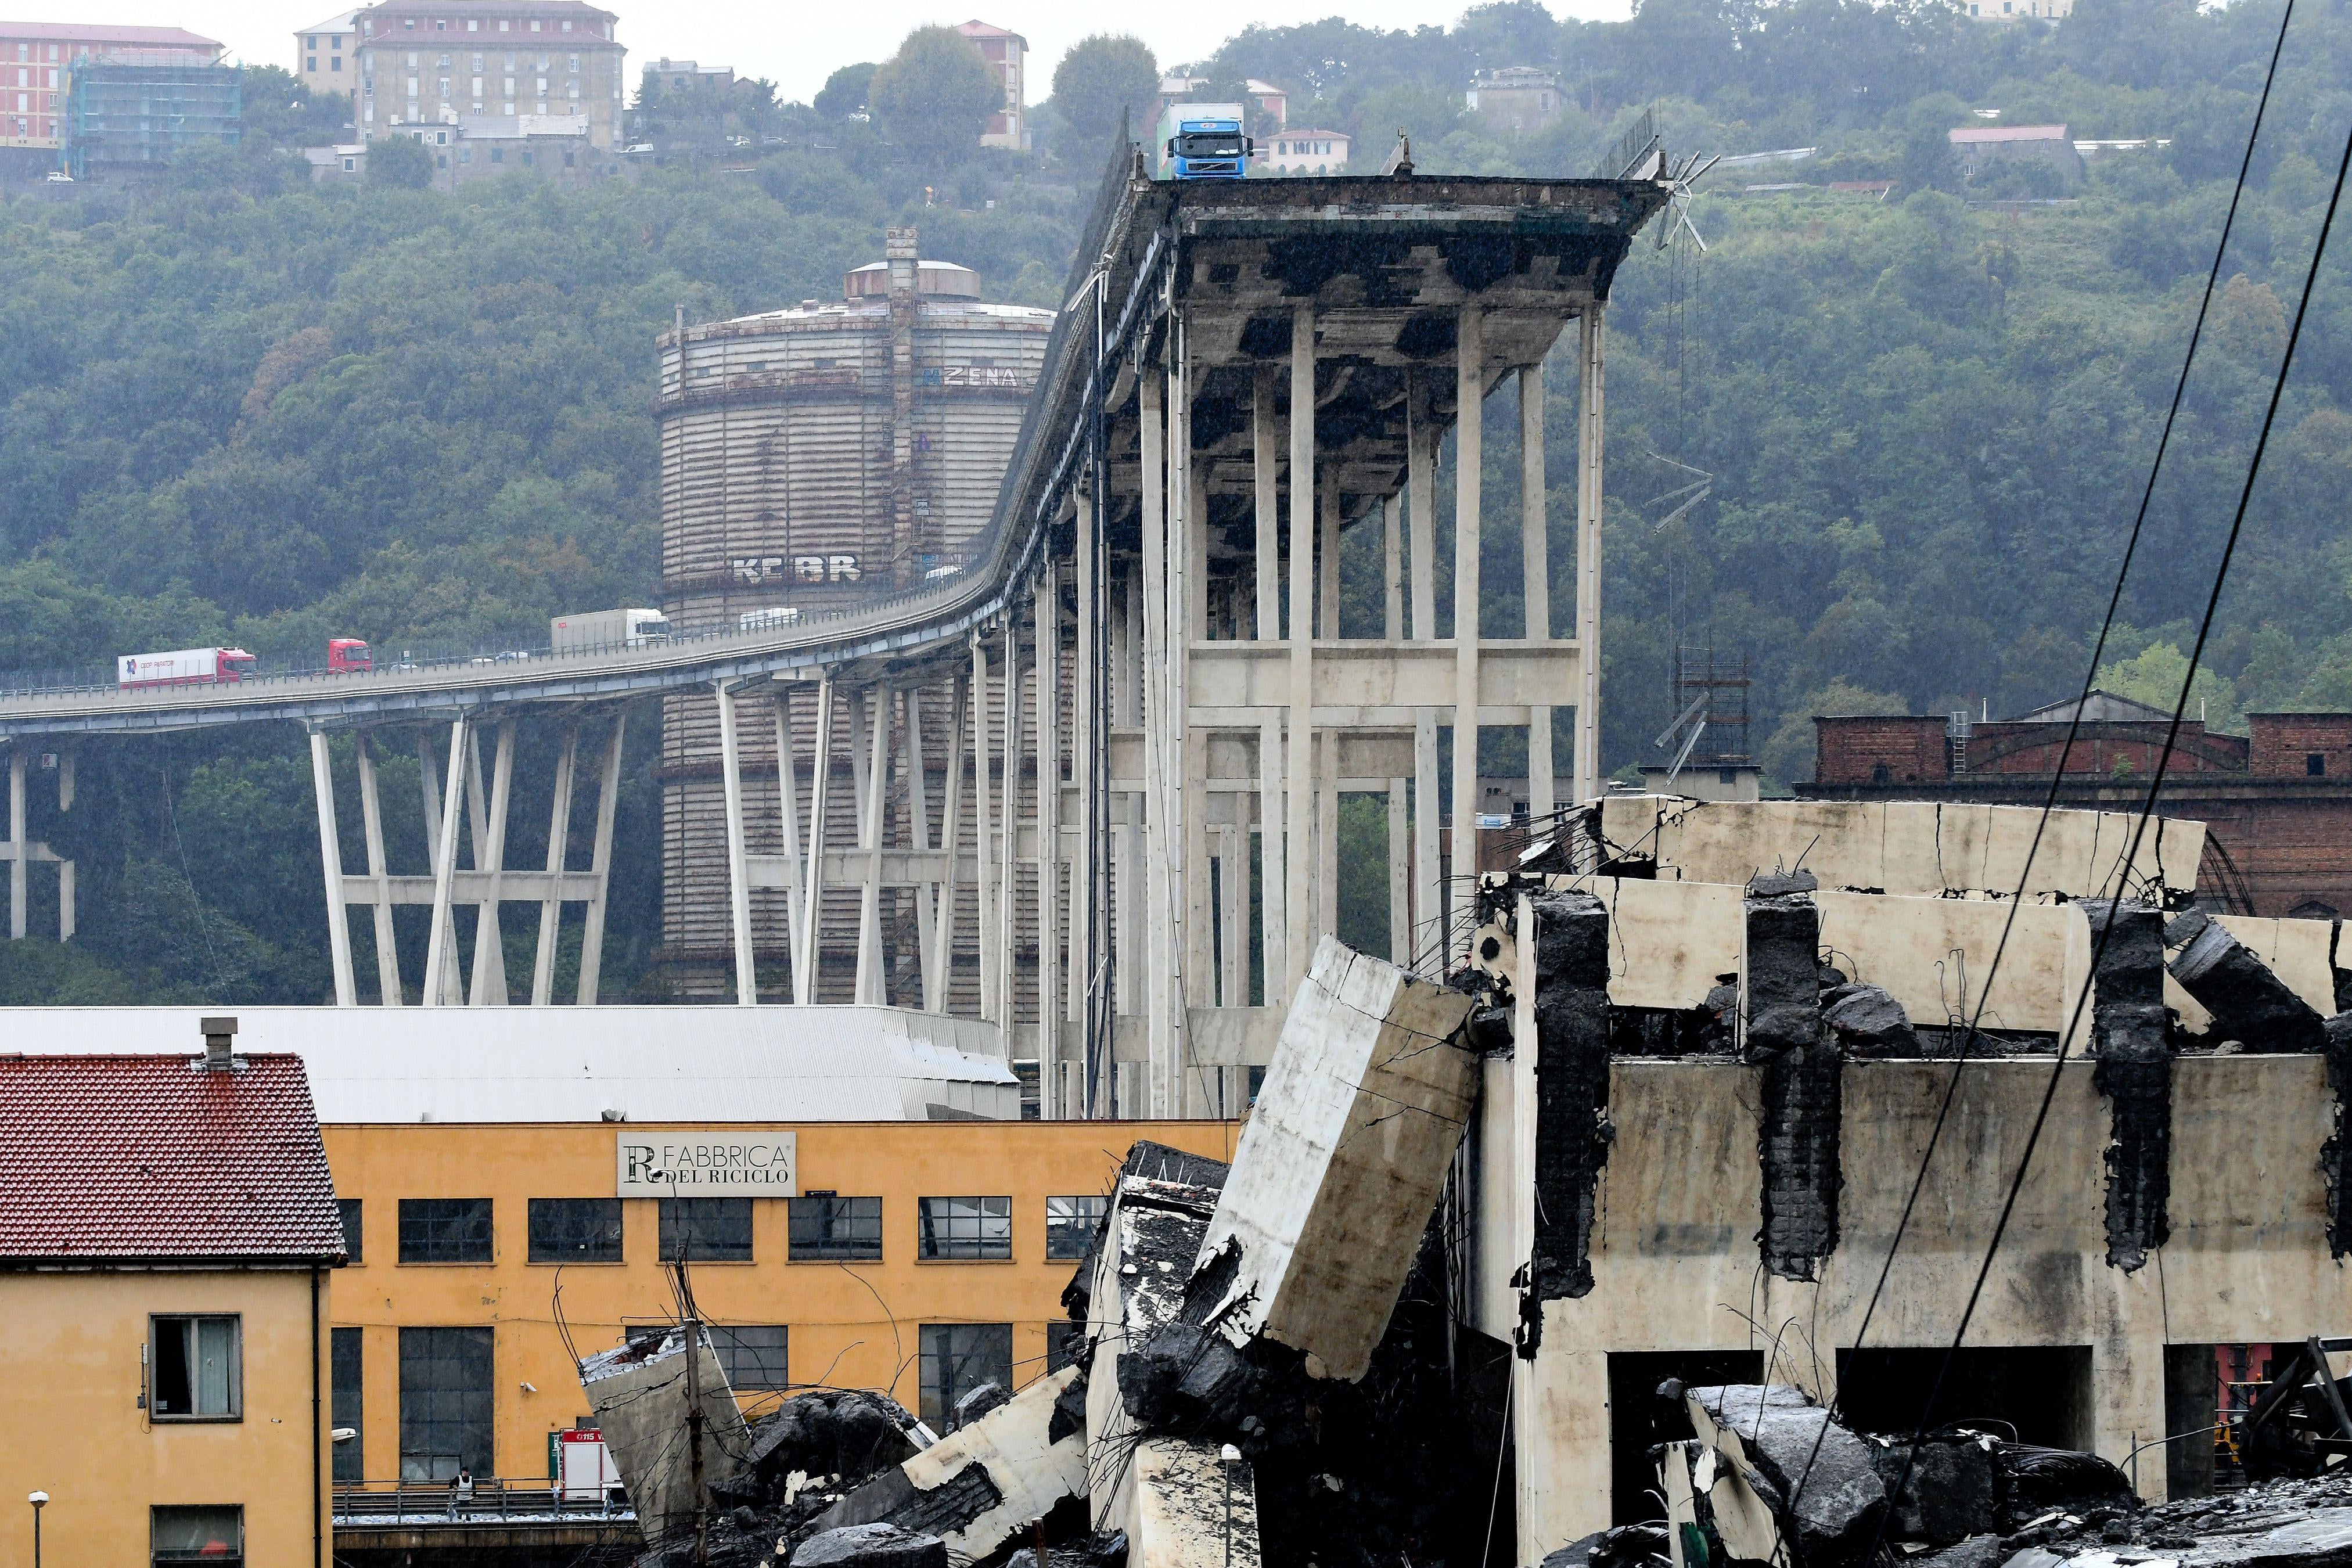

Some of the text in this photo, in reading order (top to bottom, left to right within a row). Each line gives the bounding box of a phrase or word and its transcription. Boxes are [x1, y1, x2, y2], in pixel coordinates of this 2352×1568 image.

[944, 366, 1017, 386] ZENA
[664, 1145, 787, 1167] FABBRICA
[664, 1170, 789, 1184] DEL RICICLO
